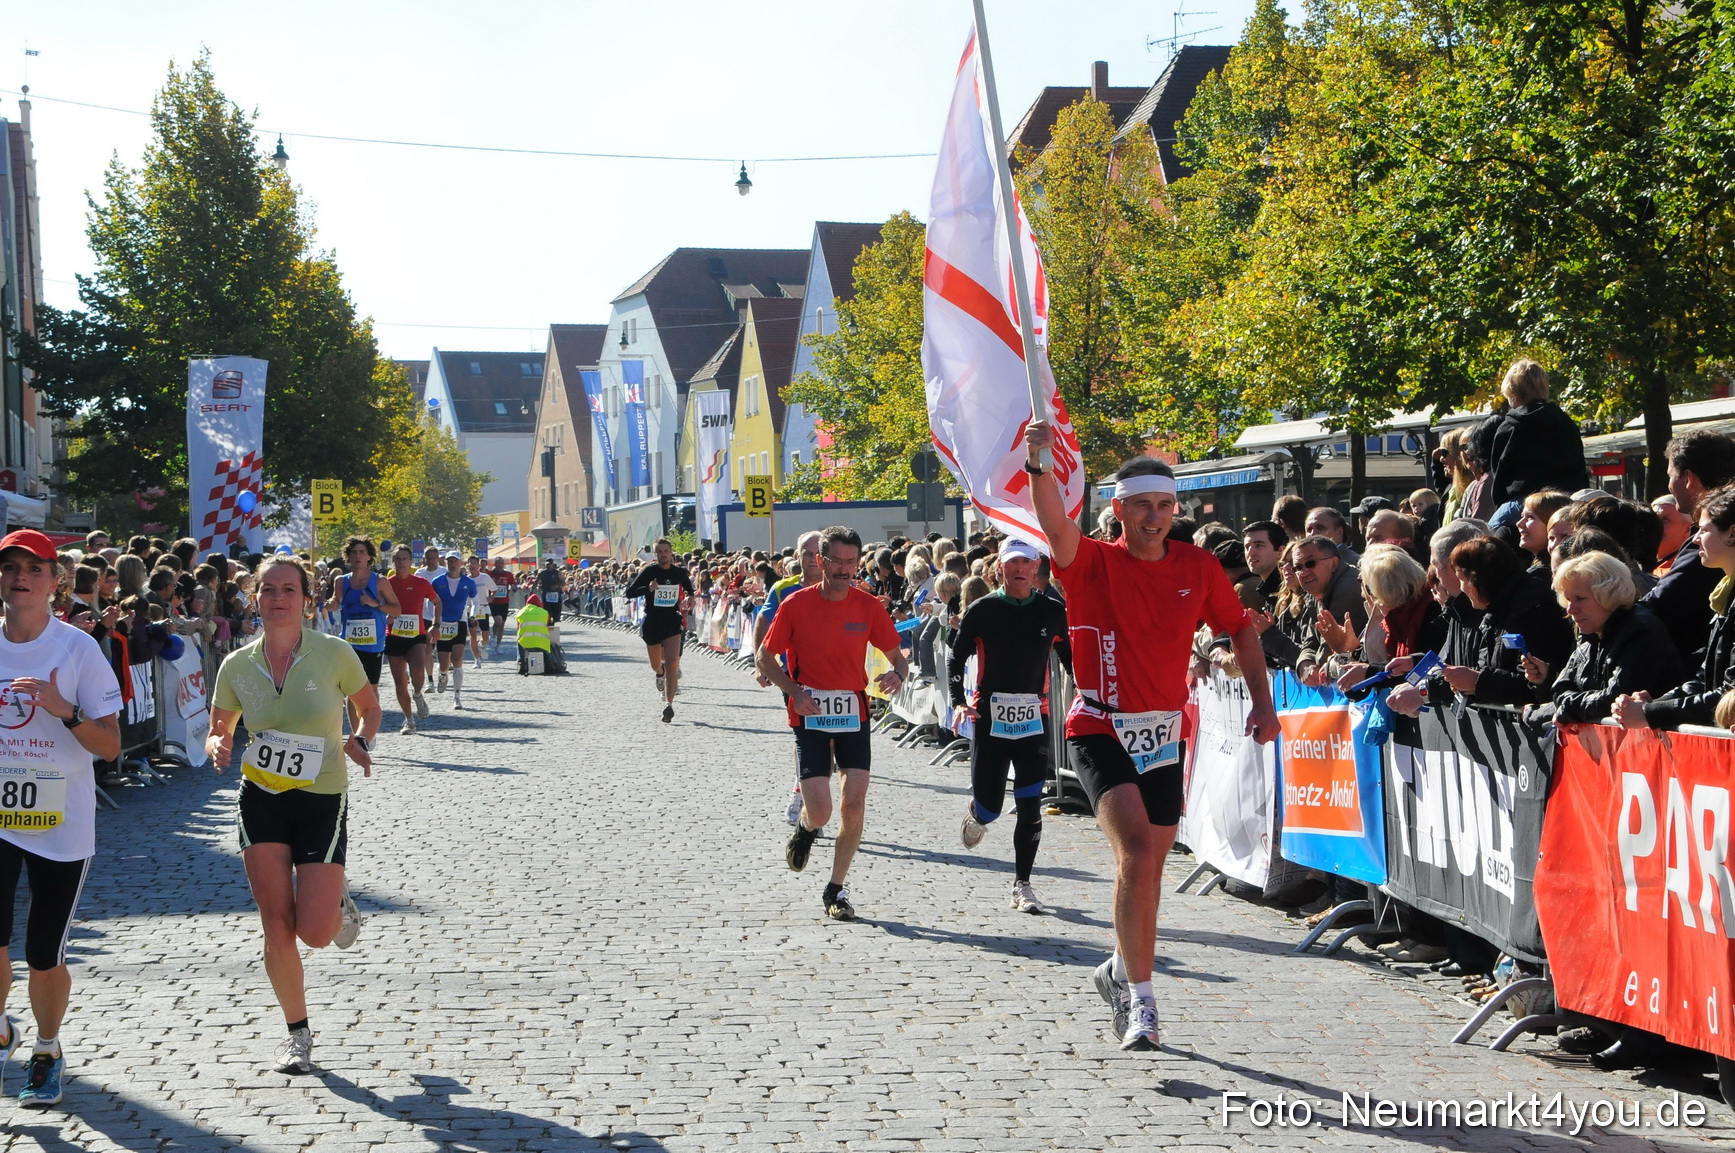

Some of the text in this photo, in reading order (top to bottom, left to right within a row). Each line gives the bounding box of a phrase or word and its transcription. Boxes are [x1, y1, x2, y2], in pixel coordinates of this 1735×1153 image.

[200, 403, 252, 413] SEAT
[315, 481, 339, 490] Block
[747, 476, 770, 485] Block
[319, 493, 335, 514] B
[751, 487, 767, 509] B
[571, 544, 579, 556] C
[398, 620, 414, 630] 709
[440, 626, 455, 634] 712
[351, 626, 370, 637] 433
[1102, 630, 1120, 719] AX BÖGL
[996, 704, 1035, 723] 2656
[816, 716, 850, 727] Werner
[1123, 715, 1158, 726] PFLEIDERER
[7, 739, 25, 747] MIT
[29, 738, 55, 748] HERZ
[1292, 732, 1327, 760] einer
[256, 744, 305, 777] 913
[2, 781, 38, 809] 80
